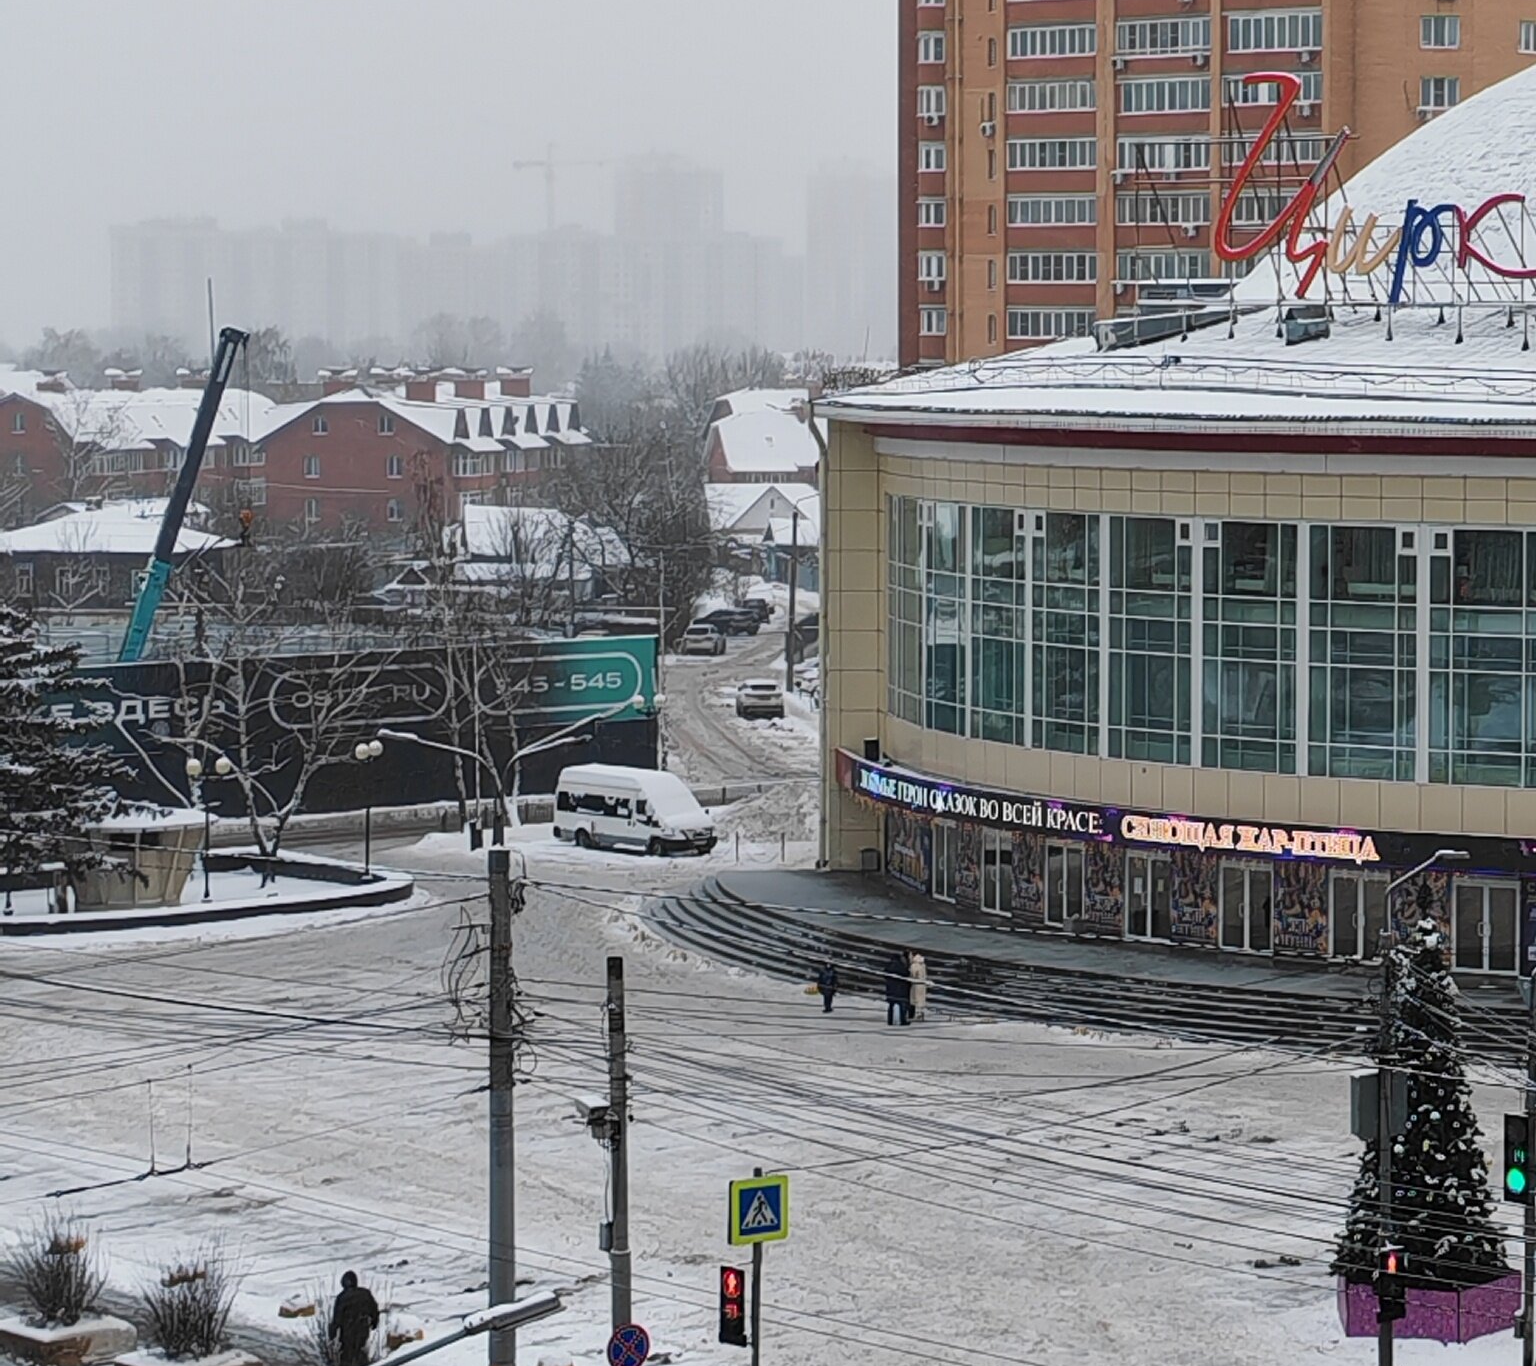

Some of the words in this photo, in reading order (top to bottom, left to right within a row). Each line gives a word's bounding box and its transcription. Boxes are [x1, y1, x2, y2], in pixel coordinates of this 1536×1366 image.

[929, 788, 978, 822] СКАЗОК
[979, 798, 999, 819] ВО
[1002, 799, 1043, 826] ВСЕЙ
[1235, 824, 1381, 865] ЖАР-ПТИЦА
